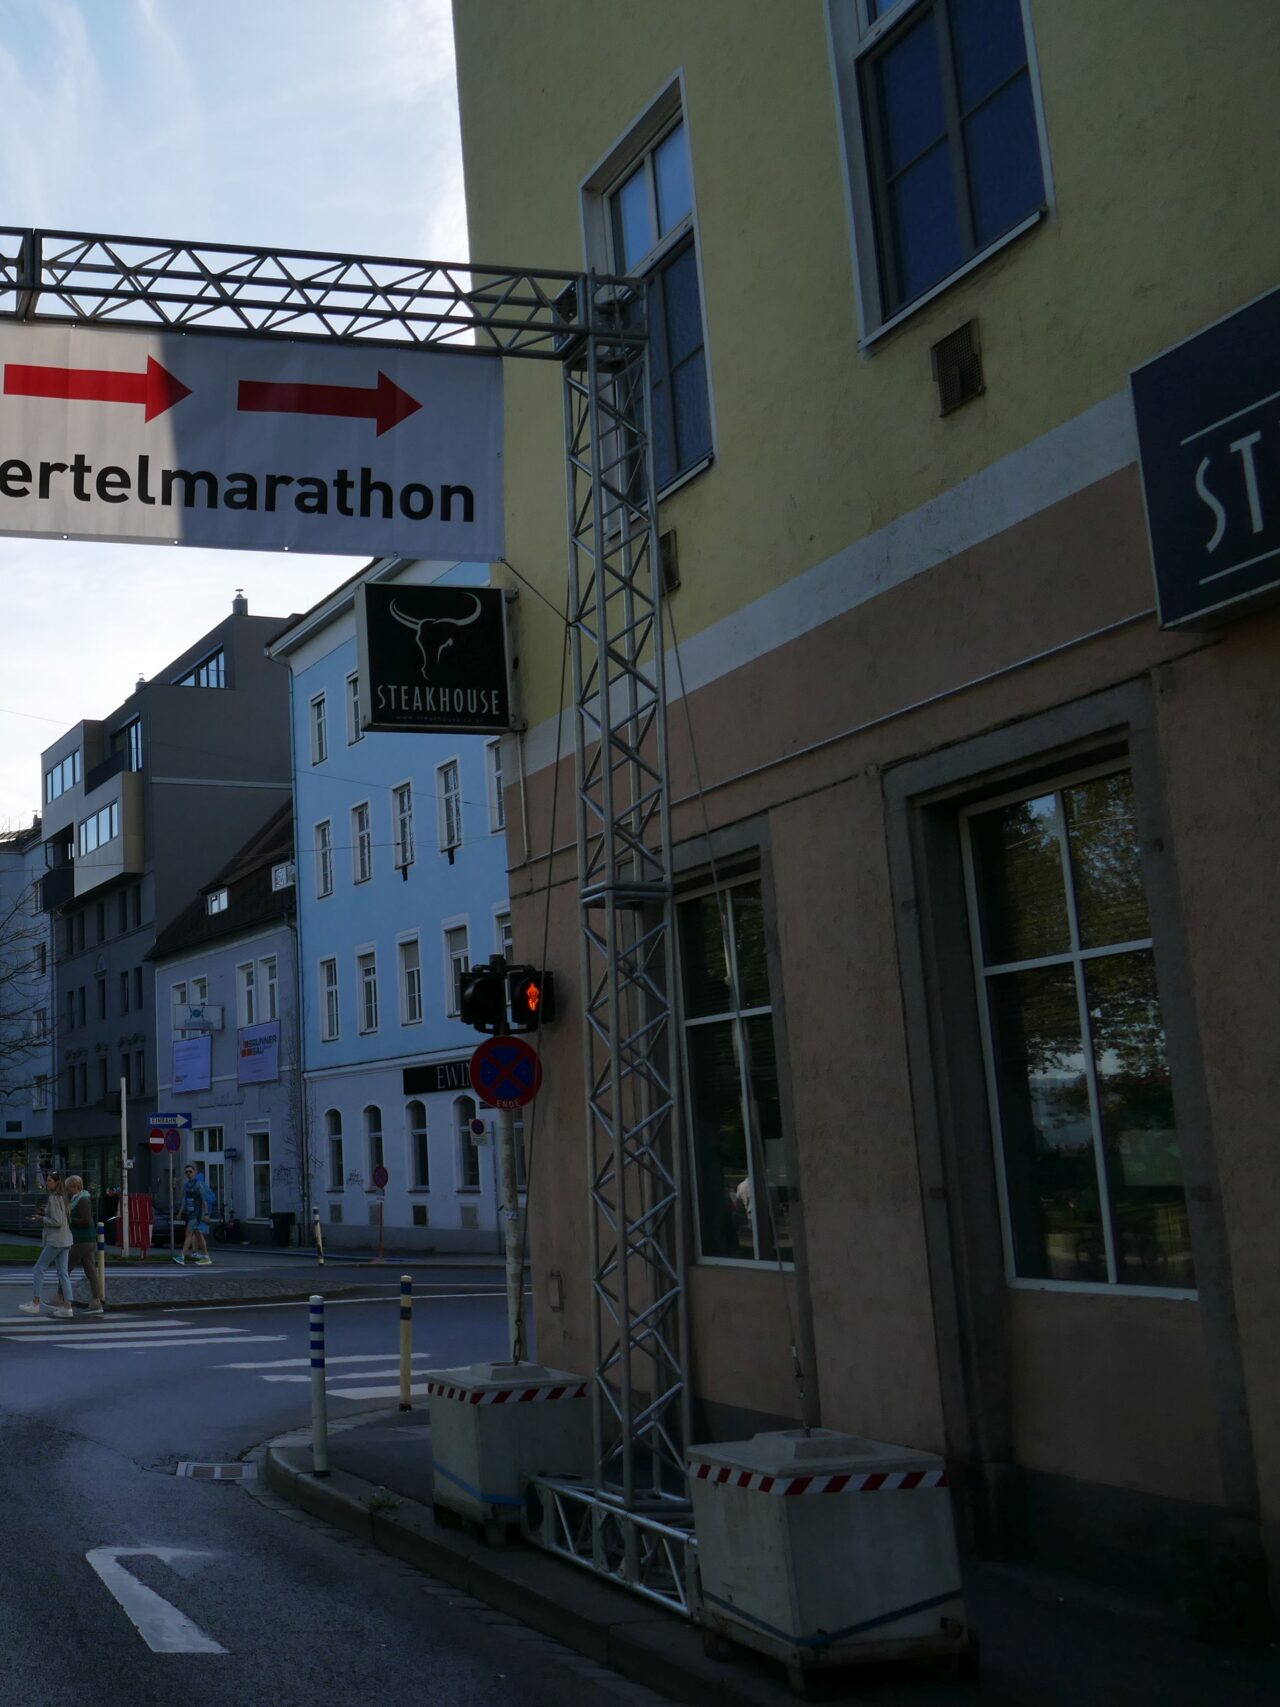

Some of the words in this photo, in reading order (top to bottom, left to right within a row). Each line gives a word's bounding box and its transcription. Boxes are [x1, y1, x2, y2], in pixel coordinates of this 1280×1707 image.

[1195, 420, 1280, 553] ST
[377, 685, 500, 715] STEAKHOUSE
[496, 1098, 521, 1108] ENDE
